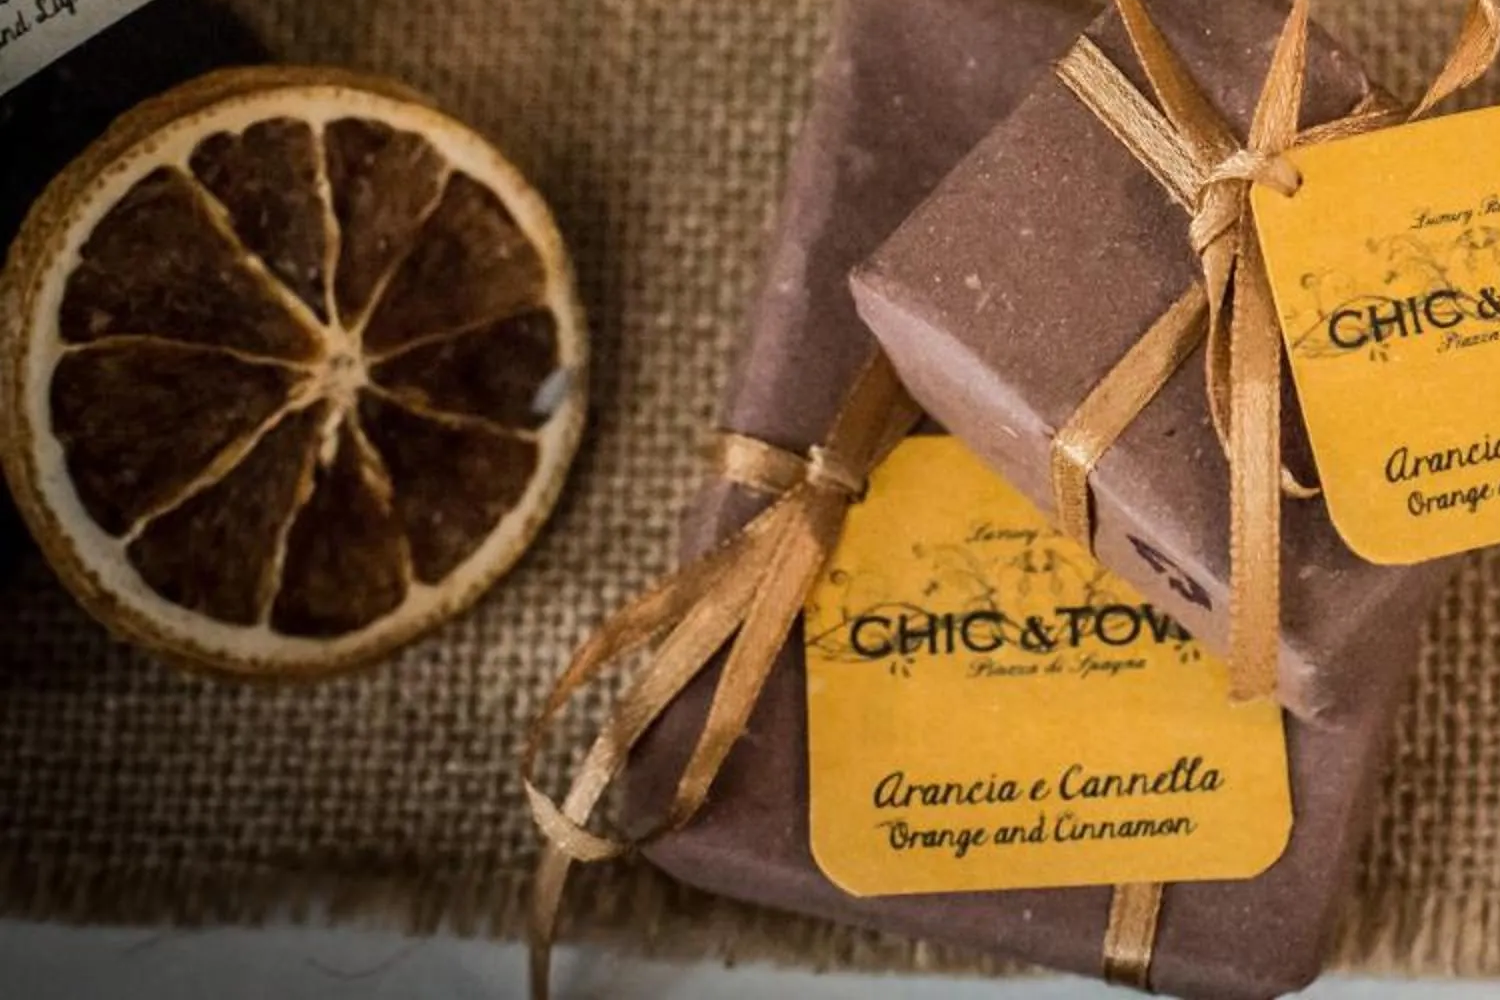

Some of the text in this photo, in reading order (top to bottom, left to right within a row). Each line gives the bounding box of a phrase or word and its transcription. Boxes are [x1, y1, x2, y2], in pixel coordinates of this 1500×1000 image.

[1328, 289, 1465, 350] CHIC
[1407, 483, 1494, 517] Orange
[850, 610, 1005, 660] CHIC
[873, 756, 1225, 809] Arancia e Cannella
[888, 810, 1198, 858] Orange and Cinnamon
